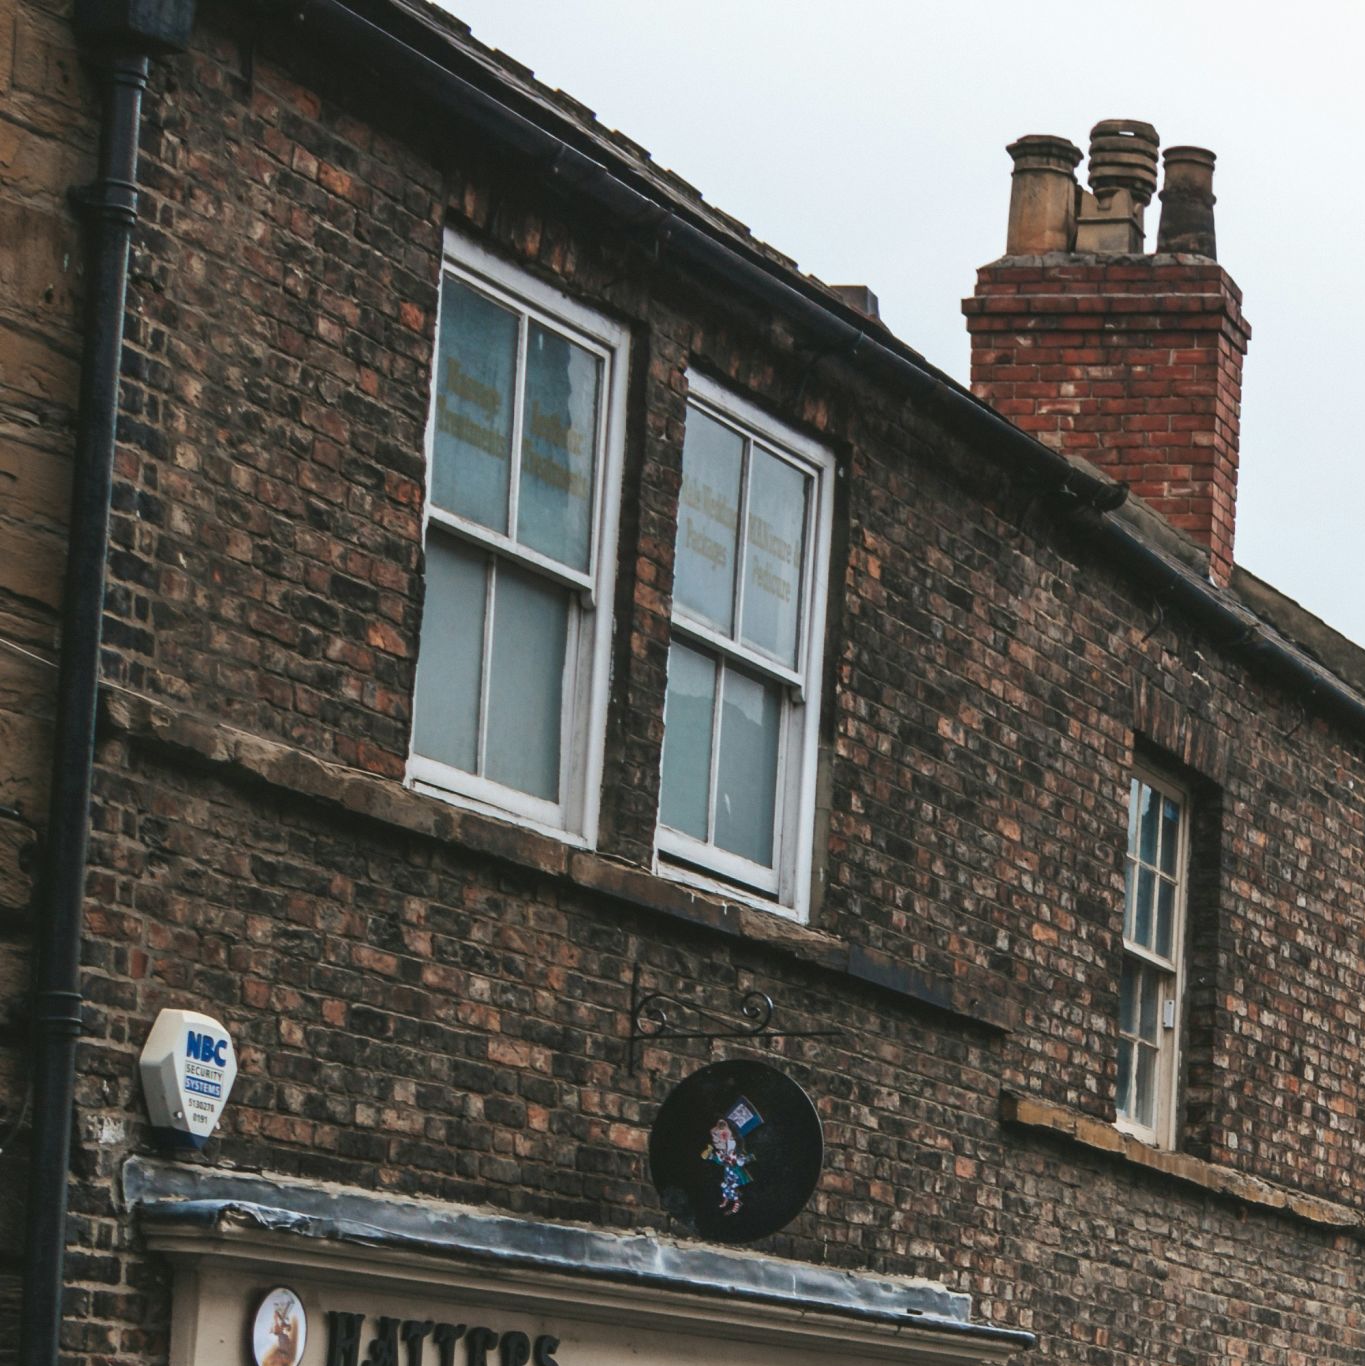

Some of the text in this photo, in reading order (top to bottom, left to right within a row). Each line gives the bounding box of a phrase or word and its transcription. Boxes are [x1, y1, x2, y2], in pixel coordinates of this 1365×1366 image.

[186, 1030, 228, 1068] NBC
[186, 1063, 222, 1080] SECURITY
[185, 1078, 221, 1096] SYSTEMS
